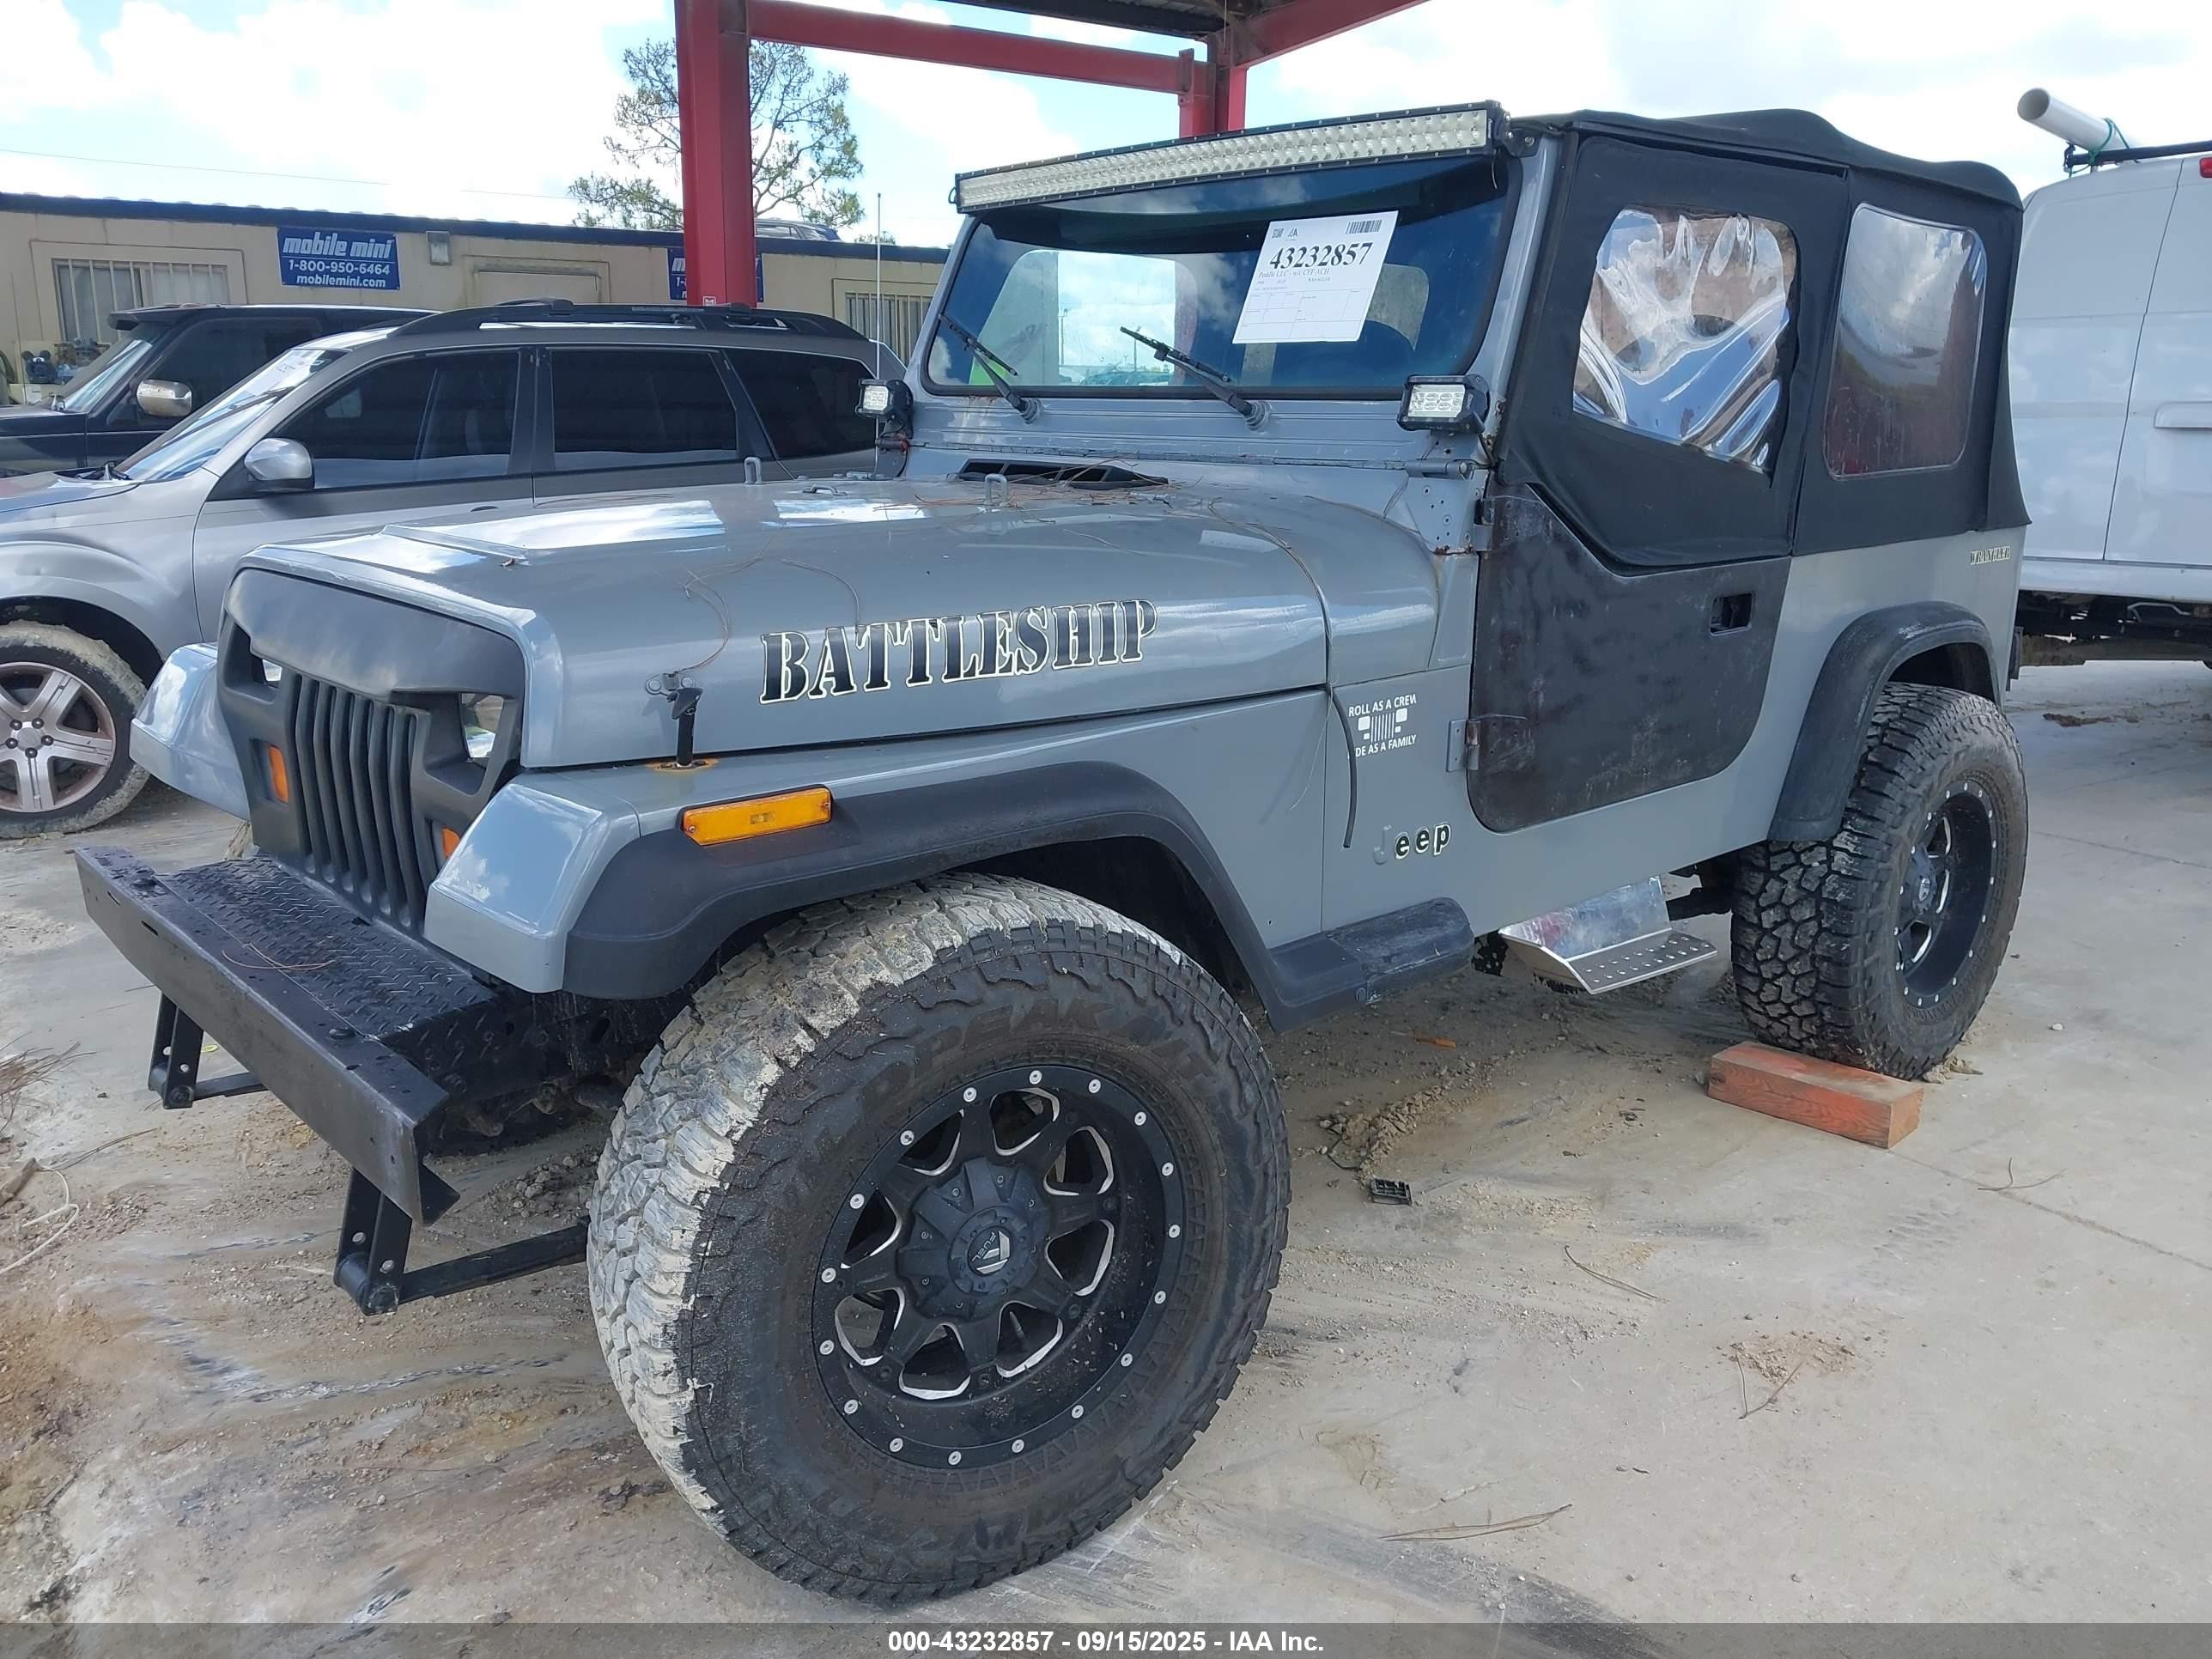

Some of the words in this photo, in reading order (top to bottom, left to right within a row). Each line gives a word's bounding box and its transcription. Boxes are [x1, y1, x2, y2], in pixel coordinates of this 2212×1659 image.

[283, 232, 347, 256] mobile
[350, 239, 393, 258] mini
[1269, 242, 1373, 269] 43232857
[289, 259, 390, 276] 1-800-950-6464
[296, 274, 386, 288] mobilemini.com
[759, 599, 1158, 705] BATTLESHIP
[1348, 703, 1370, 717] ROLL
[1372, 700, 1384, 712] AS
[1385, 699, 1392, 710] A
[1368, 743, 1379, 755] AS
[1380, 742, 1386, 751] A
[1388, 735, 1416, 749] FAMILY
[971, 1231, 996, 1261] FUEL
